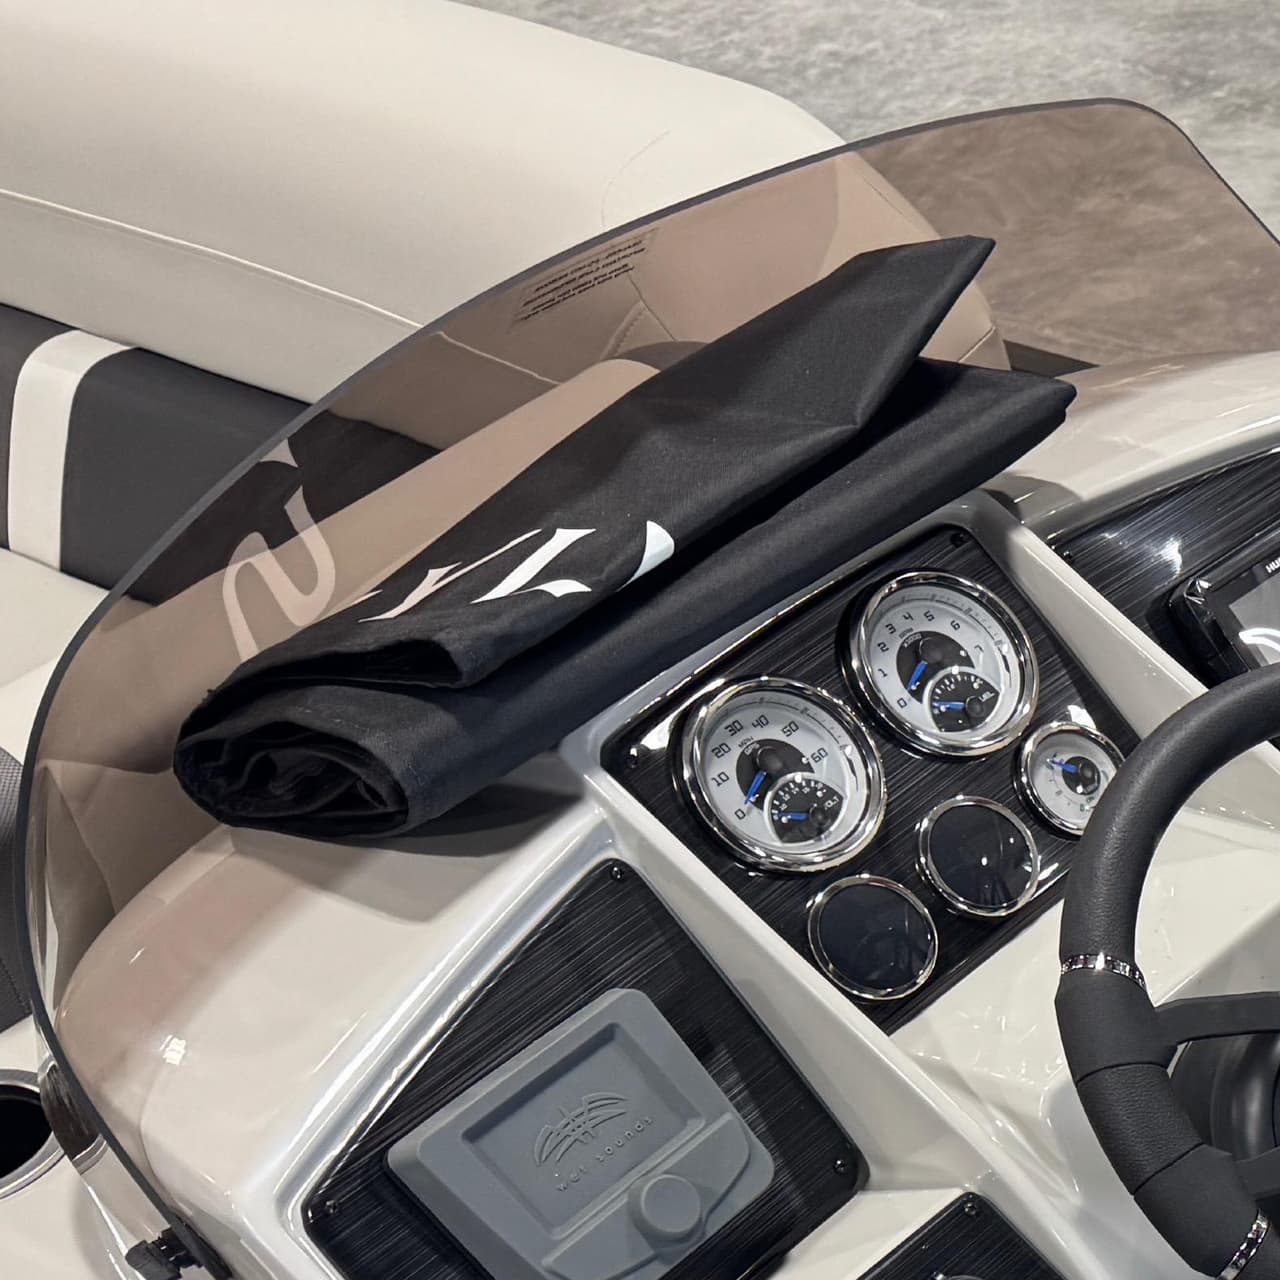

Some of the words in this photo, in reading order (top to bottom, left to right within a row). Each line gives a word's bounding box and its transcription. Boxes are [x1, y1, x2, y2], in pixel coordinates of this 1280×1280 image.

[903, 612, 914, 620] 4
[923, 610, 935, 622] 5
[886, 623, 896, 635] 3
[951, 620, 960, 630] 6
[878, 642, 889, 652] 2
[878, 668, 887, 677] 1
[897, 697, 907, 708] 0
[724, 720, 743, 736] 30
[752, 715, 769, 729] 40
[781, 721, 799, 737] 50
[712, 742, 731, 758] 20
[811, 747, 828, 763] 60
[712, 772, 730, 787] 10
[734, 809, 746, 820] 0
[595, 1117, 654, 1164] sounds
